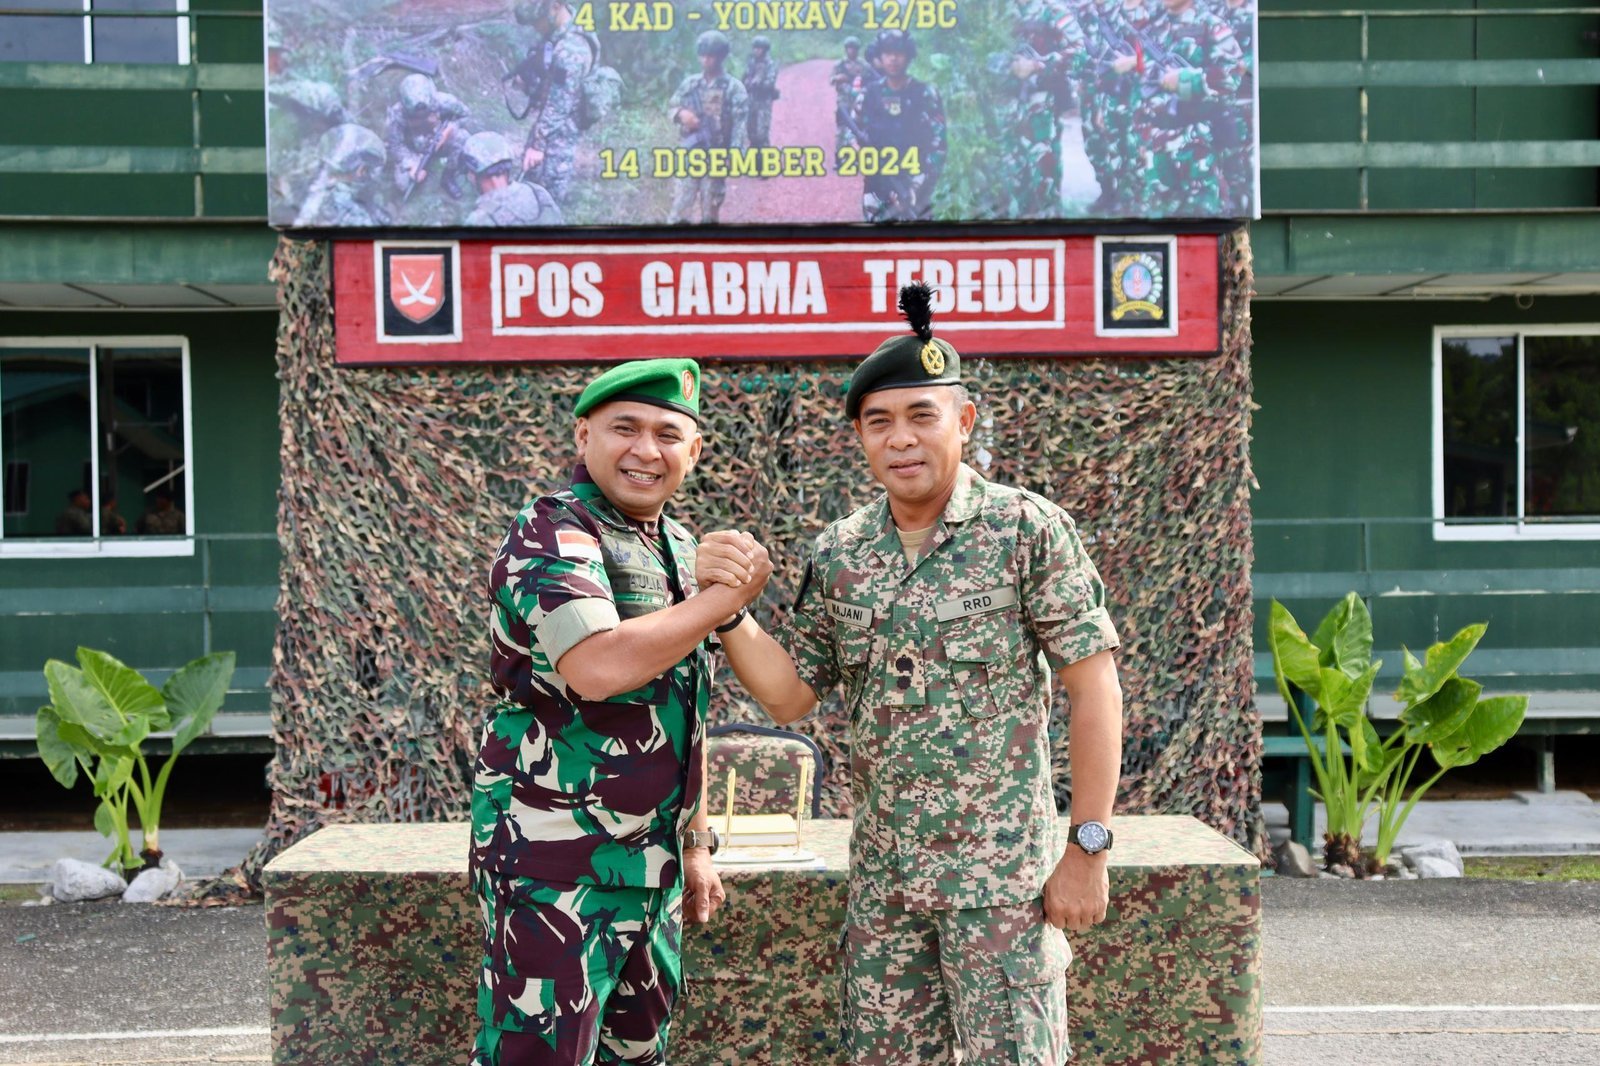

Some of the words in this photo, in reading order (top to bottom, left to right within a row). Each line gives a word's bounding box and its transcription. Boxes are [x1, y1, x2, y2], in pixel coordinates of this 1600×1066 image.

[575, 2, 595, 32] 4
[608, 2, 674, 31] KAD
[717, 1, 848, 31] YONKAV
[862, 0, 958, 31] 12/BC
[600, 149, 640, 179] 14
[653, 147, 825, 178] DISEMBER
[837, 146, 922, 176] 2024
[504, 261, 604, 318] POS
[640, 259, 828, 318] GABMA
[963, 596, 992, 611] RRD
